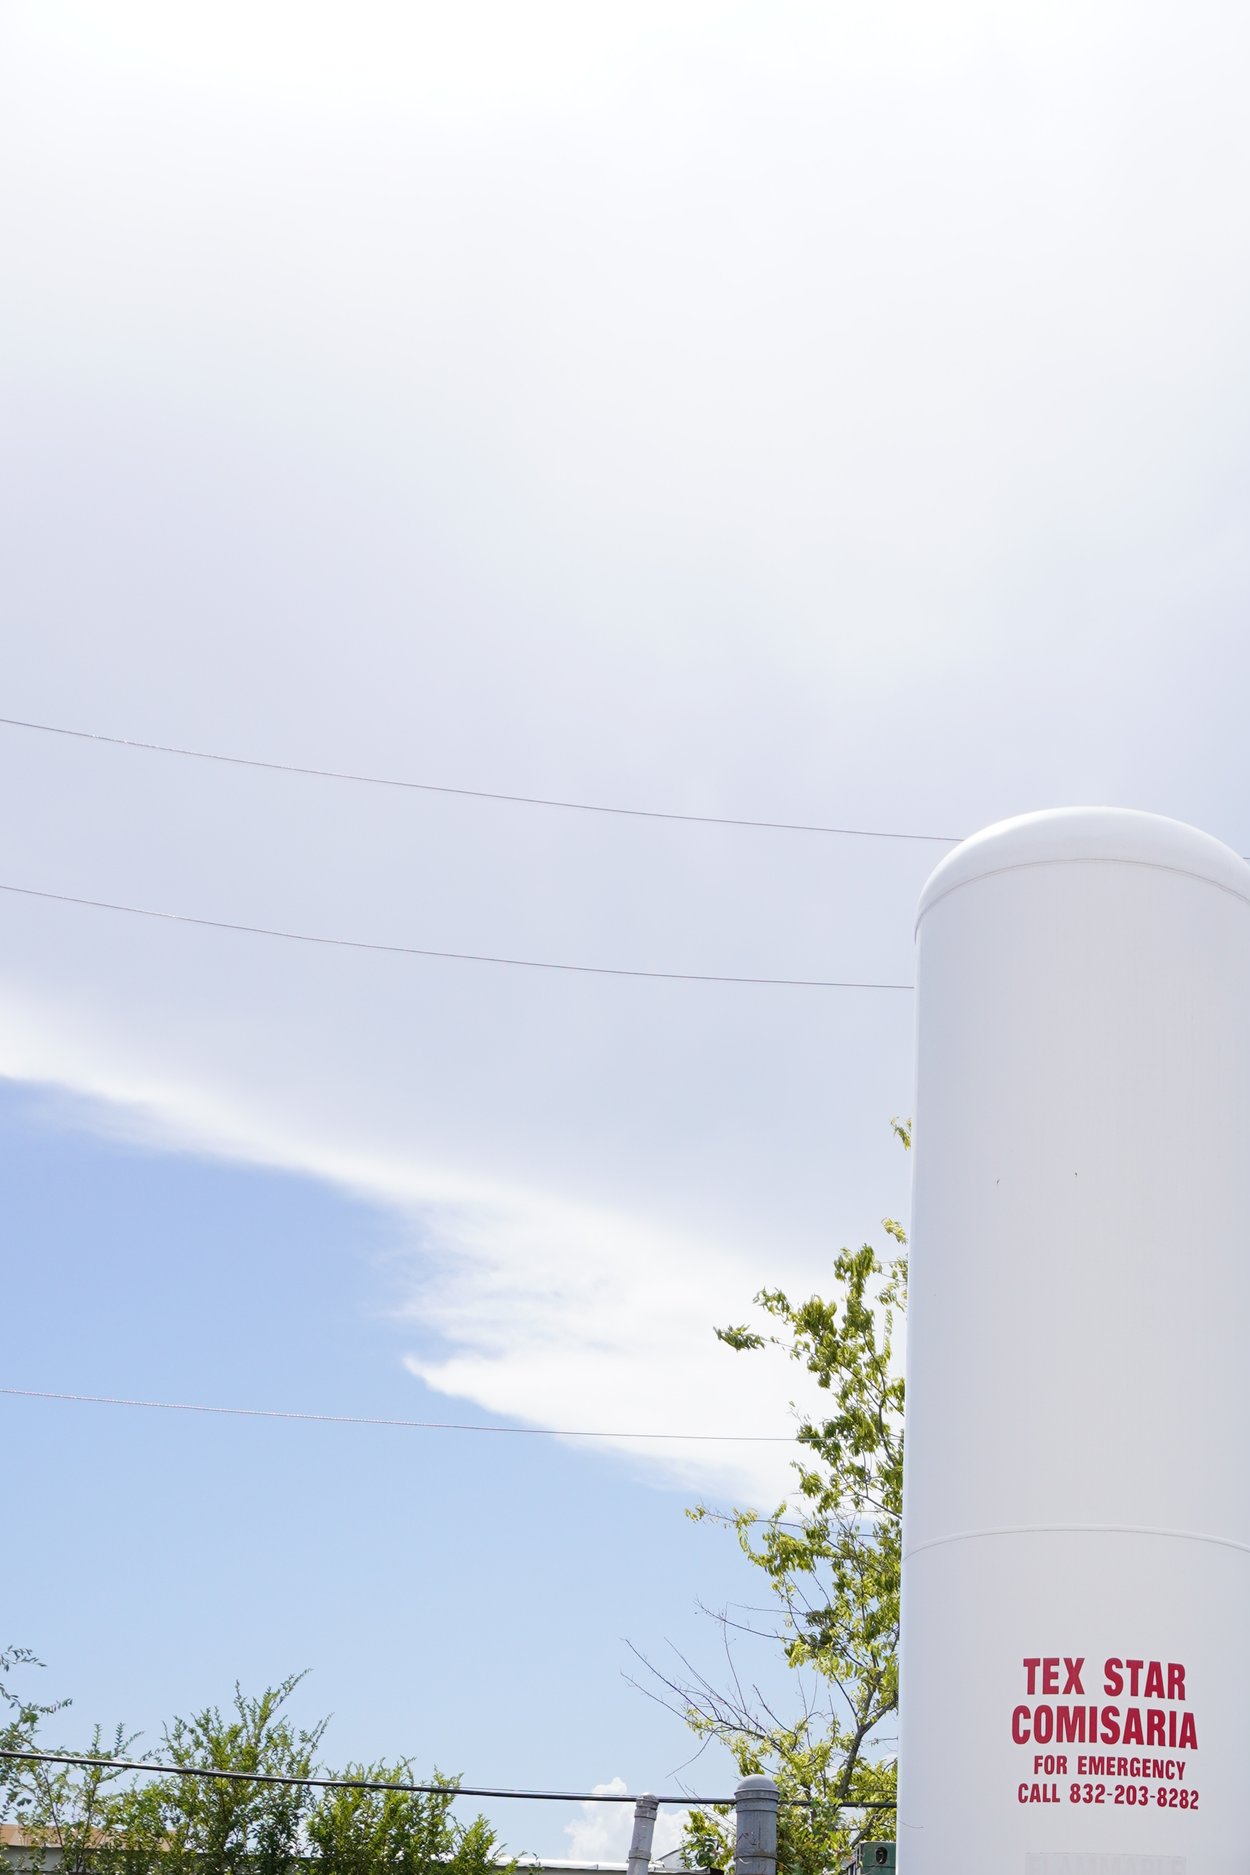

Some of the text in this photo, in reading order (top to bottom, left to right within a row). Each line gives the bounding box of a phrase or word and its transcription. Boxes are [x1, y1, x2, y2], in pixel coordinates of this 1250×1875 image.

[1023, 1657, 1186, 1701] TEX STAR
[1011, 1704, 1198, 1750] COMISARIA
[1033, 1755, 1186, 1781] FOR EMERGENCY
[1018, 1783, 1199, 1810] CALL 832-203-8282
